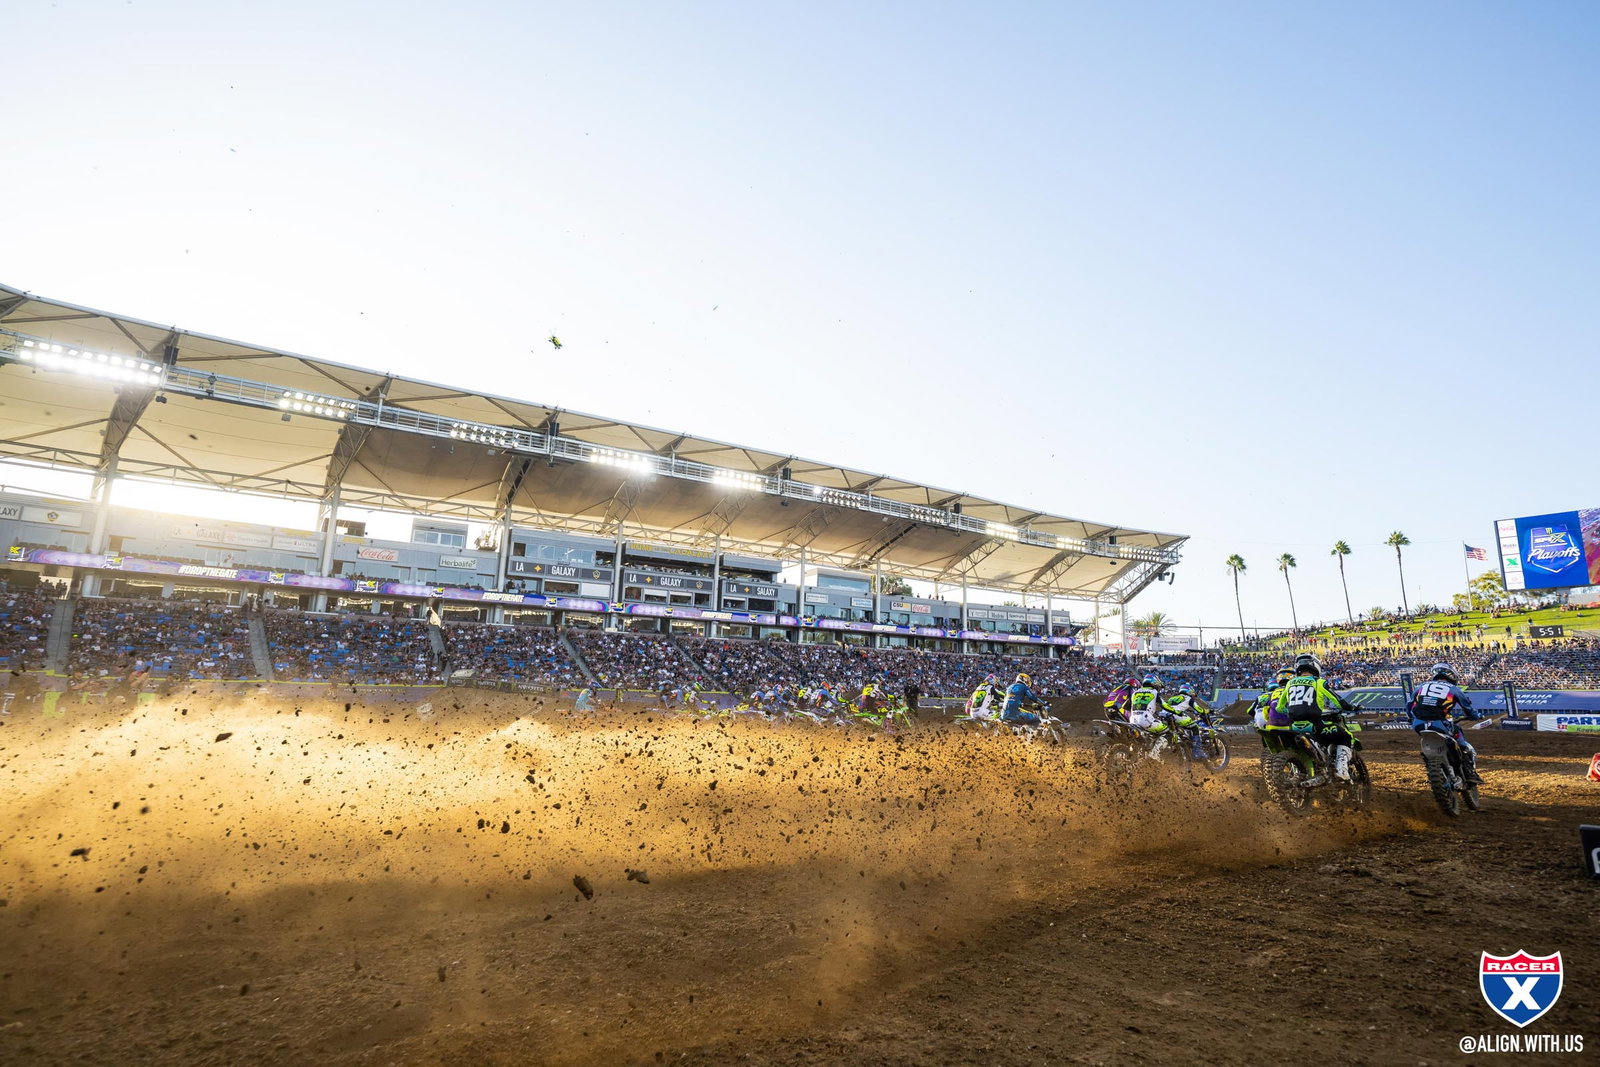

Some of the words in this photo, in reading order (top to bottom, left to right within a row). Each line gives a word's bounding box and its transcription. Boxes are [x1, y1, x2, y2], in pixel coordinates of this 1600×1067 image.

[1527, 546, 1580, 562] Playoffs
[441, 559, 473, 568] Herbalife
[516, 562, 524, 572] LA
[551, 565, 576, 577] GALAXY
[178, 565, 239, 579] #DROPTHEGATE
[629, 573, 637, 583] LA
[660, 577, 682, 587] GALAXY
[730, 584, 737, 593] LA
[1288, 685, 1315, 706] 224
[1420, 683, 1450, 699] 19
